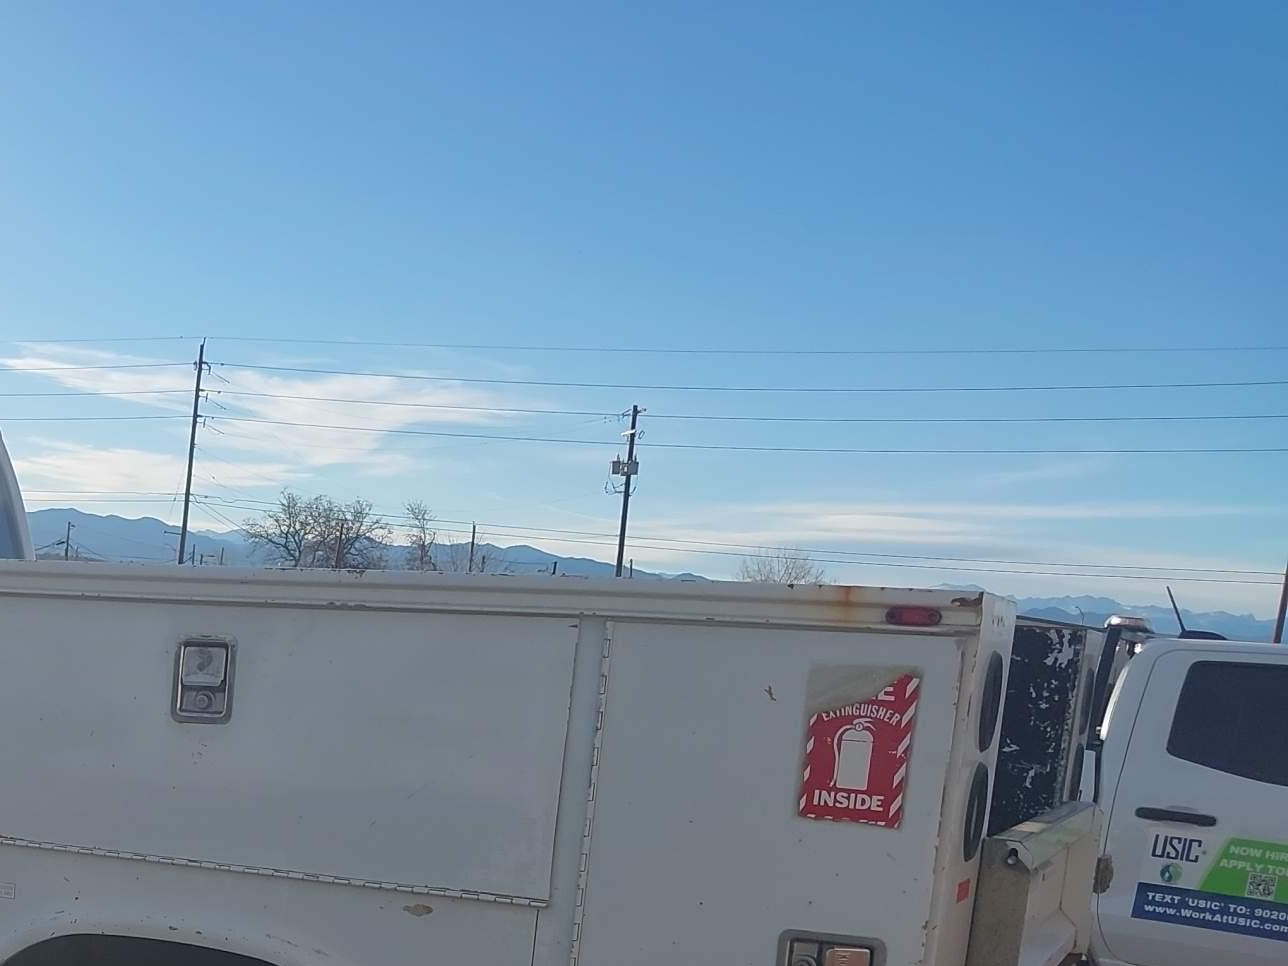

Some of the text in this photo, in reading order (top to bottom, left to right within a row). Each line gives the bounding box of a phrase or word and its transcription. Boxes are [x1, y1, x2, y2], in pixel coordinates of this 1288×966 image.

[813, 789, 885, 811] INSIDE
[1151, 834, 1203, 863] USIC
[1229, 845, 1263, 858] NOW
[1219, 858, 1288, 877] APPLY TO
[1146, 891, 1181, 904] TEXT
[1228, 903, 1250, 915] TO:
[1254, 908, 1288, 921] 9020
